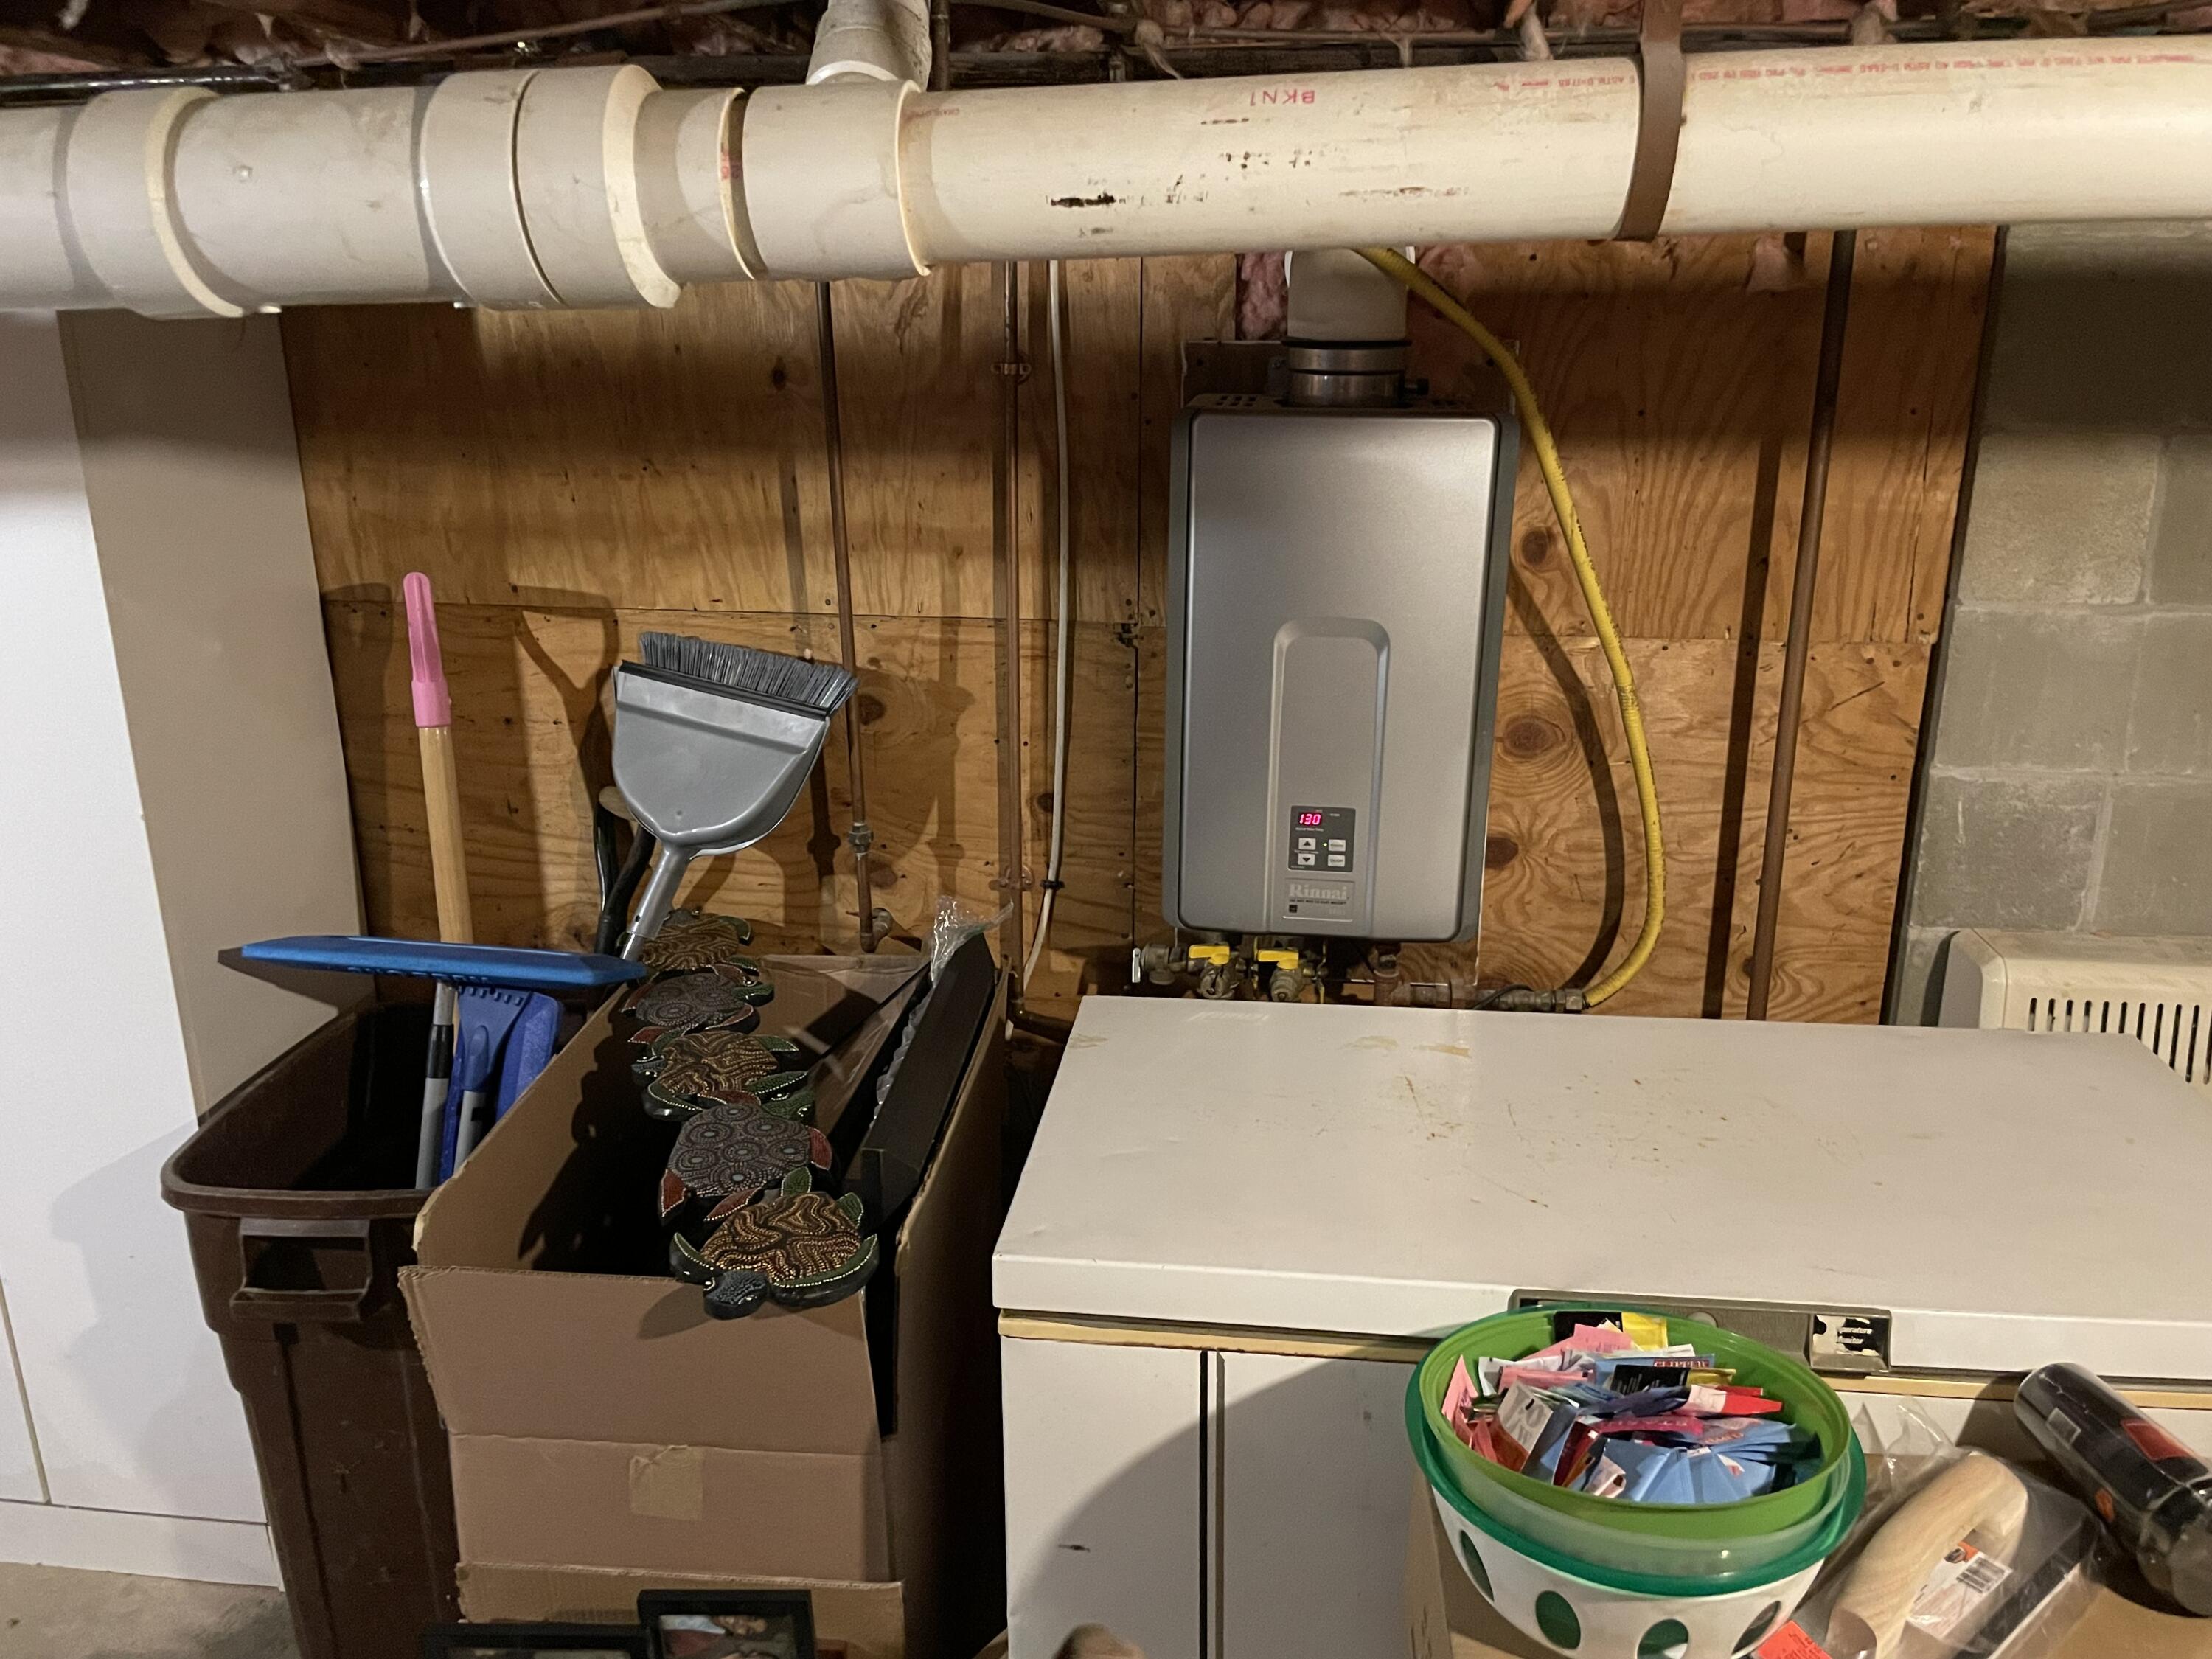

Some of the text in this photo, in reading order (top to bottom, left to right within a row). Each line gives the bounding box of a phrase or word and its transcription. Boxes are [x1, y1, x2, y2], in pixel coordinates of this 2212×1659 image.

[1249, 88, 1315, 107] BKN1
[1299, 813, 1321, 825] 130
[1289, 884, 1347, 900] Rinnai
